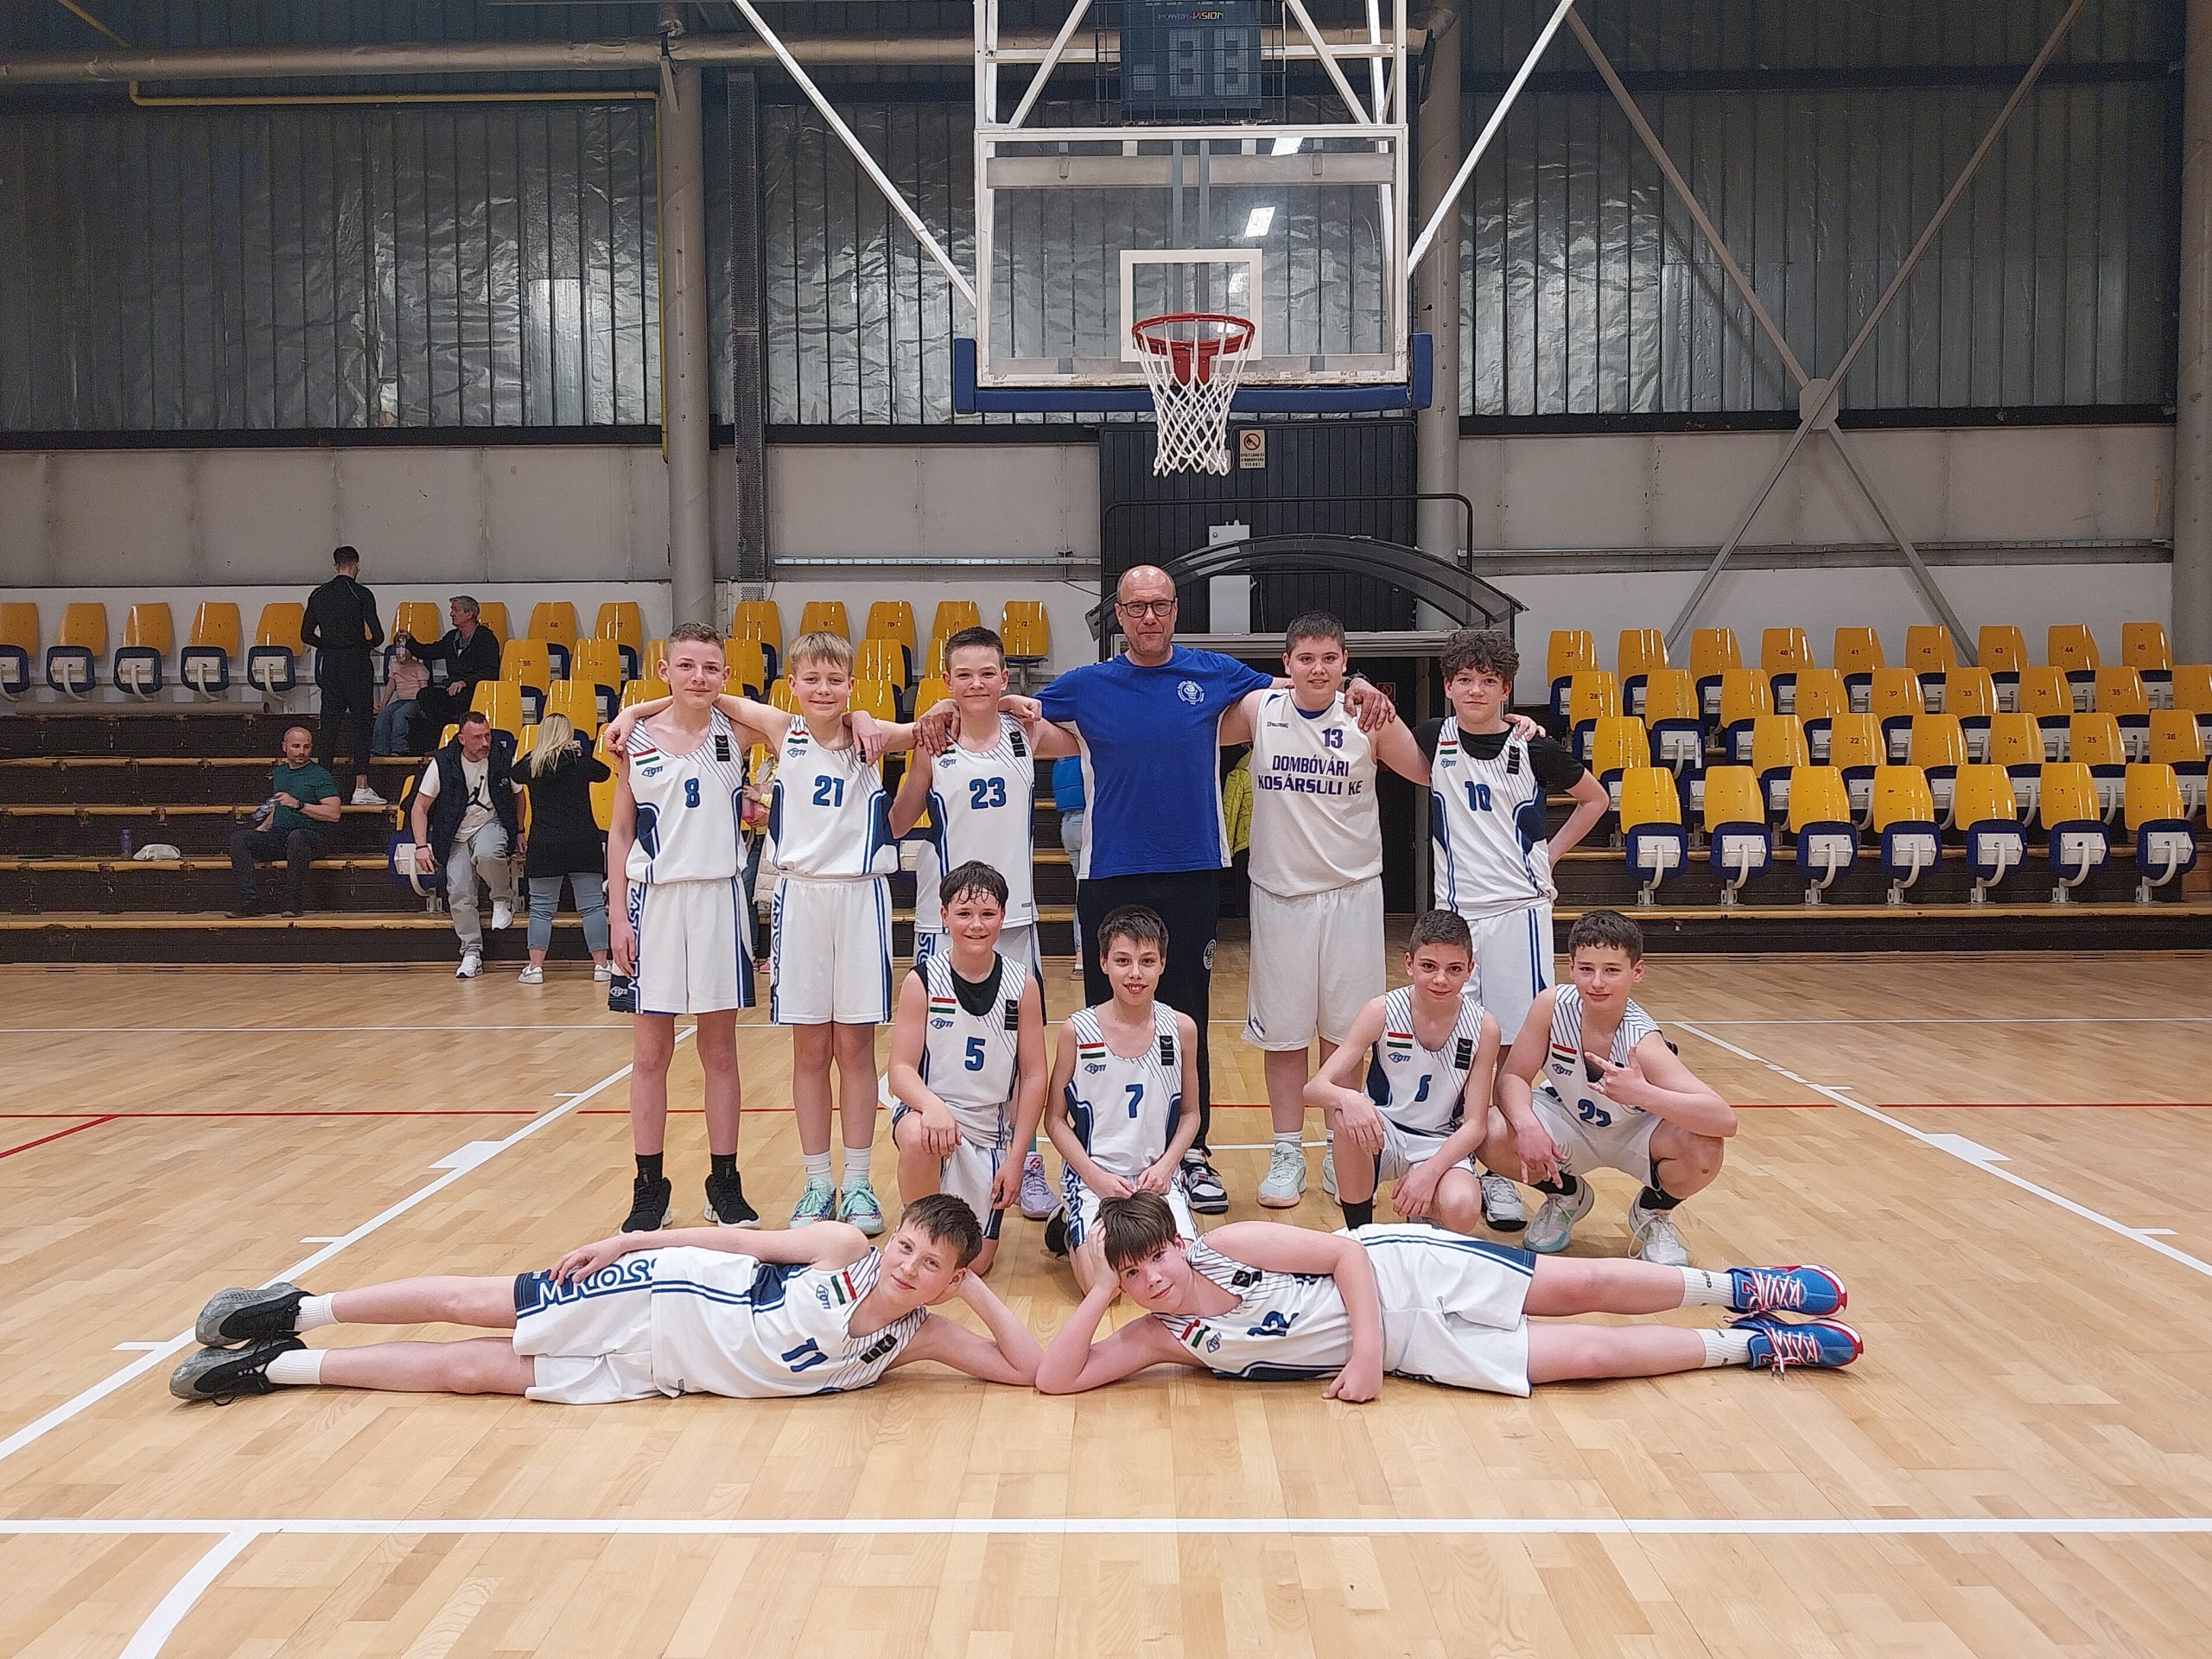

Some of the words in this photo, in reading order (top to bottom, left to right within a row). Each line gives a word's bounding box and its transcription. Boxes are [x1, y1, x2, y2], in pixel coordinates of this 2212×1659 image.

[1322, 728, 1344, 749] 13
[1272, 754, 1350, 777] DOMBÓVÁRI
[684, 778, 700, 808] 8
[813, 775, 845, 807] 21
[969, 777, 1007, 810] 23
[1258, 773, 1343, 795] KOSÁRSULI
[1348, 779, 1363, 795] KE
[1465, 781, 1492, 812] 10
[931, 1018, 954, 1029] TOTI
[964, 1036, 986, 1071] 5
[1086, 1063, 1107, 1074] TOTI
[1389, 1052, 1411, 1063] TOTI
[1125, 1084, 1143, 1118] 7
[781, 1337, 829, 1372] 11
